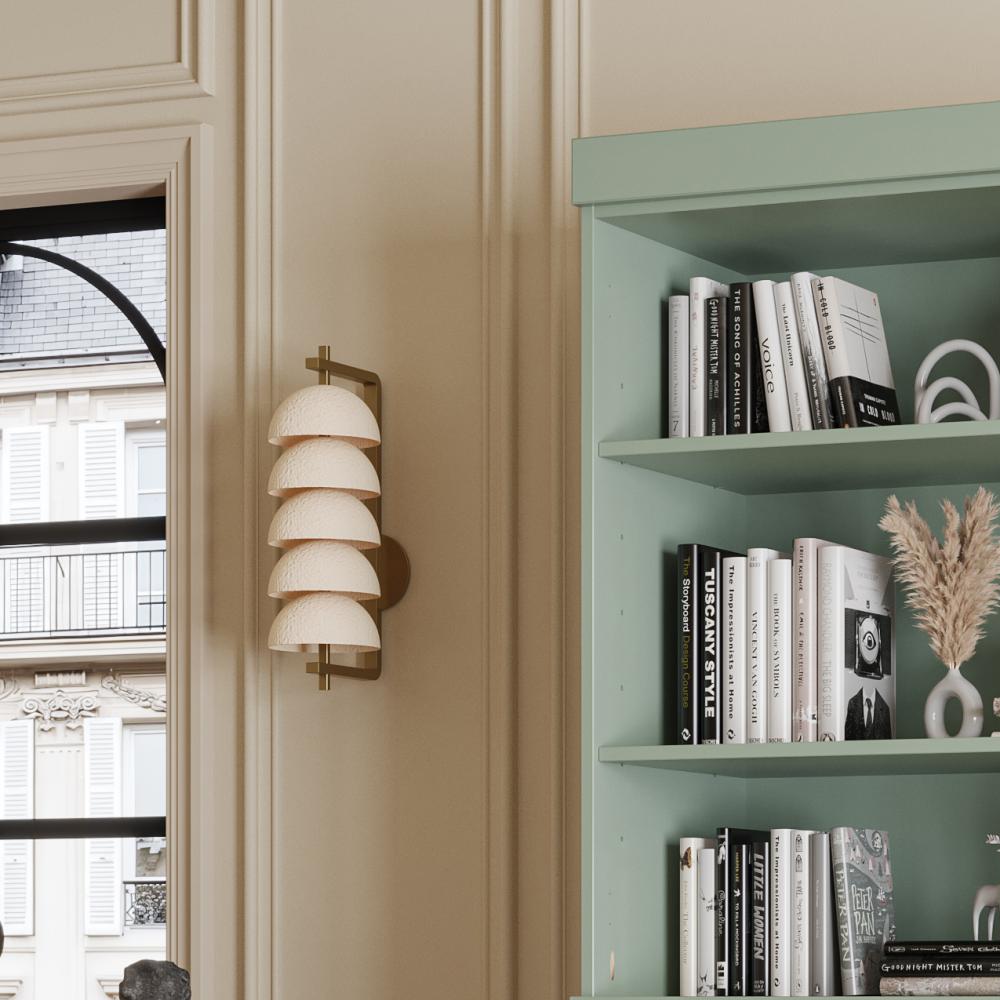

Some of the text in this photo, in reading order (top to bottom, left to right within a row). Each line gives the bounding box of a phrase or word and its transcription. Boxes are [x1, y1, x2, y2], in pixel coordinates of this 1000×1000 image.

[734, 352, 740, 368] OF
[681, 578, 690, 632] Storyboard
[704, 568, 715, 718] TUSCANY STYLE
[728, 674, 734, 684] at
[754, 853, 764, 960] LITTLE WOMEN
[851, 884, 874, 911] PETER
[836, 870, 850, 962] PETER PAN
[854, 911, 876, 936] PAN
[775, 930, 780, 940] at
[881, 964, 934, 972] GOODNIGHT
[936, 963, 965, 972] MISTER
